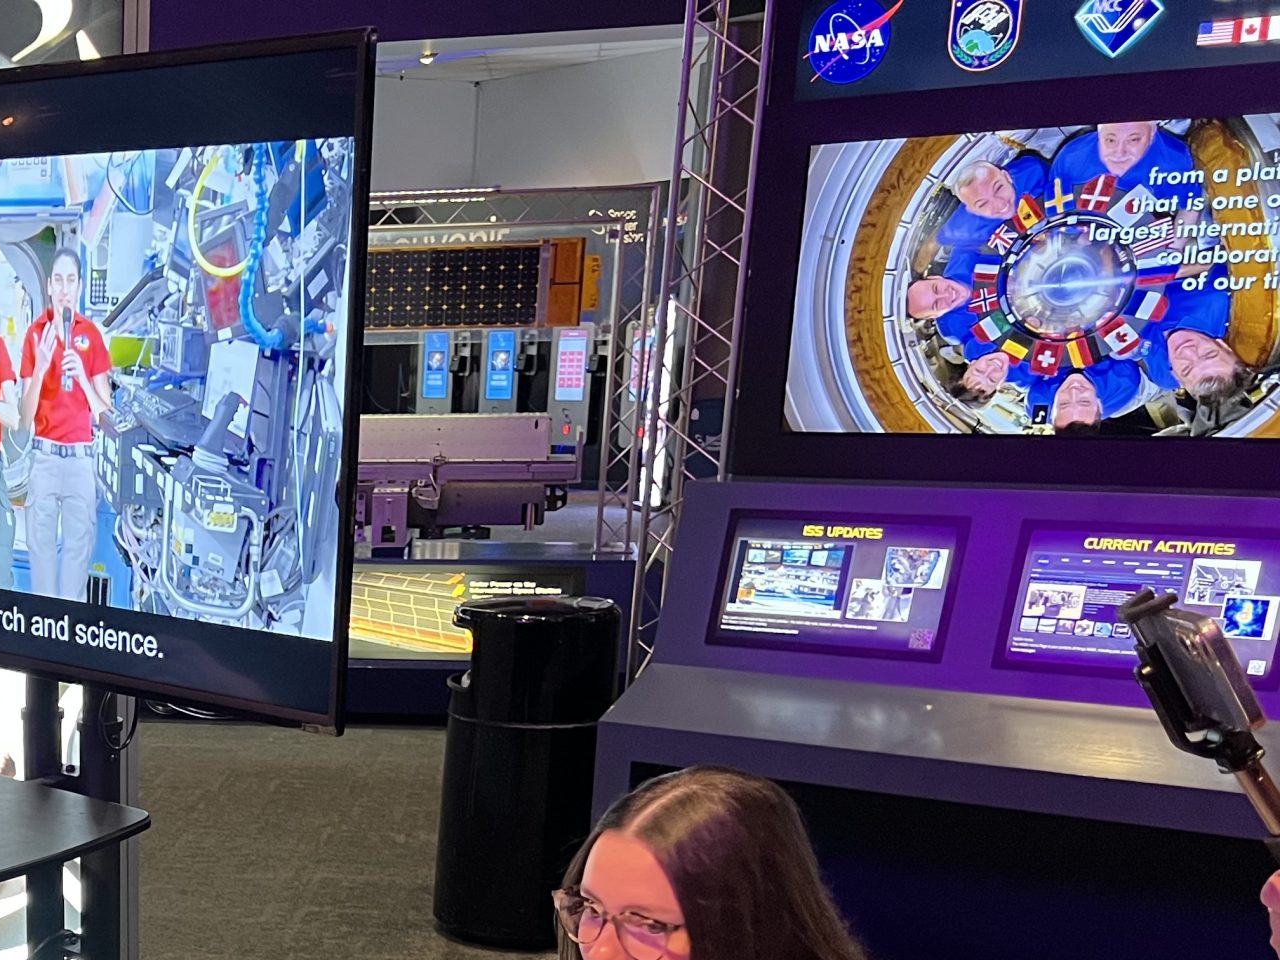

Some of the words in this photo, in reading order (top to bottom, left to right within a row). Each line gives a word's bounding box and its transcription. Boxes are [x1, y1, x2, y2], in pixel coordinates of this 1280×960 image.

[813, 29, 885, 53] NASA
[1148, 166, 1205, 186] from
[1212, 169, 1228, 183] a
[1131, 193, 1180, 213] that
[1186, 192, 1205, 211] is
[1212, 195, 1264, 210] one
[1088, 222, 1171, 245] largest
[1181, 271, 1209, 291] of
[1213, 275, 1258, 291] our
[802, 525, 824, 537] ISS
[827, 526, 884, 540] UPDATES
[1083, 537, 1152, 552] CURRENT
[1154, 540, 1236, 556] ACTIVITIES
[30, 614, 70, 642] and
[75, 621, 165, 659] science.
